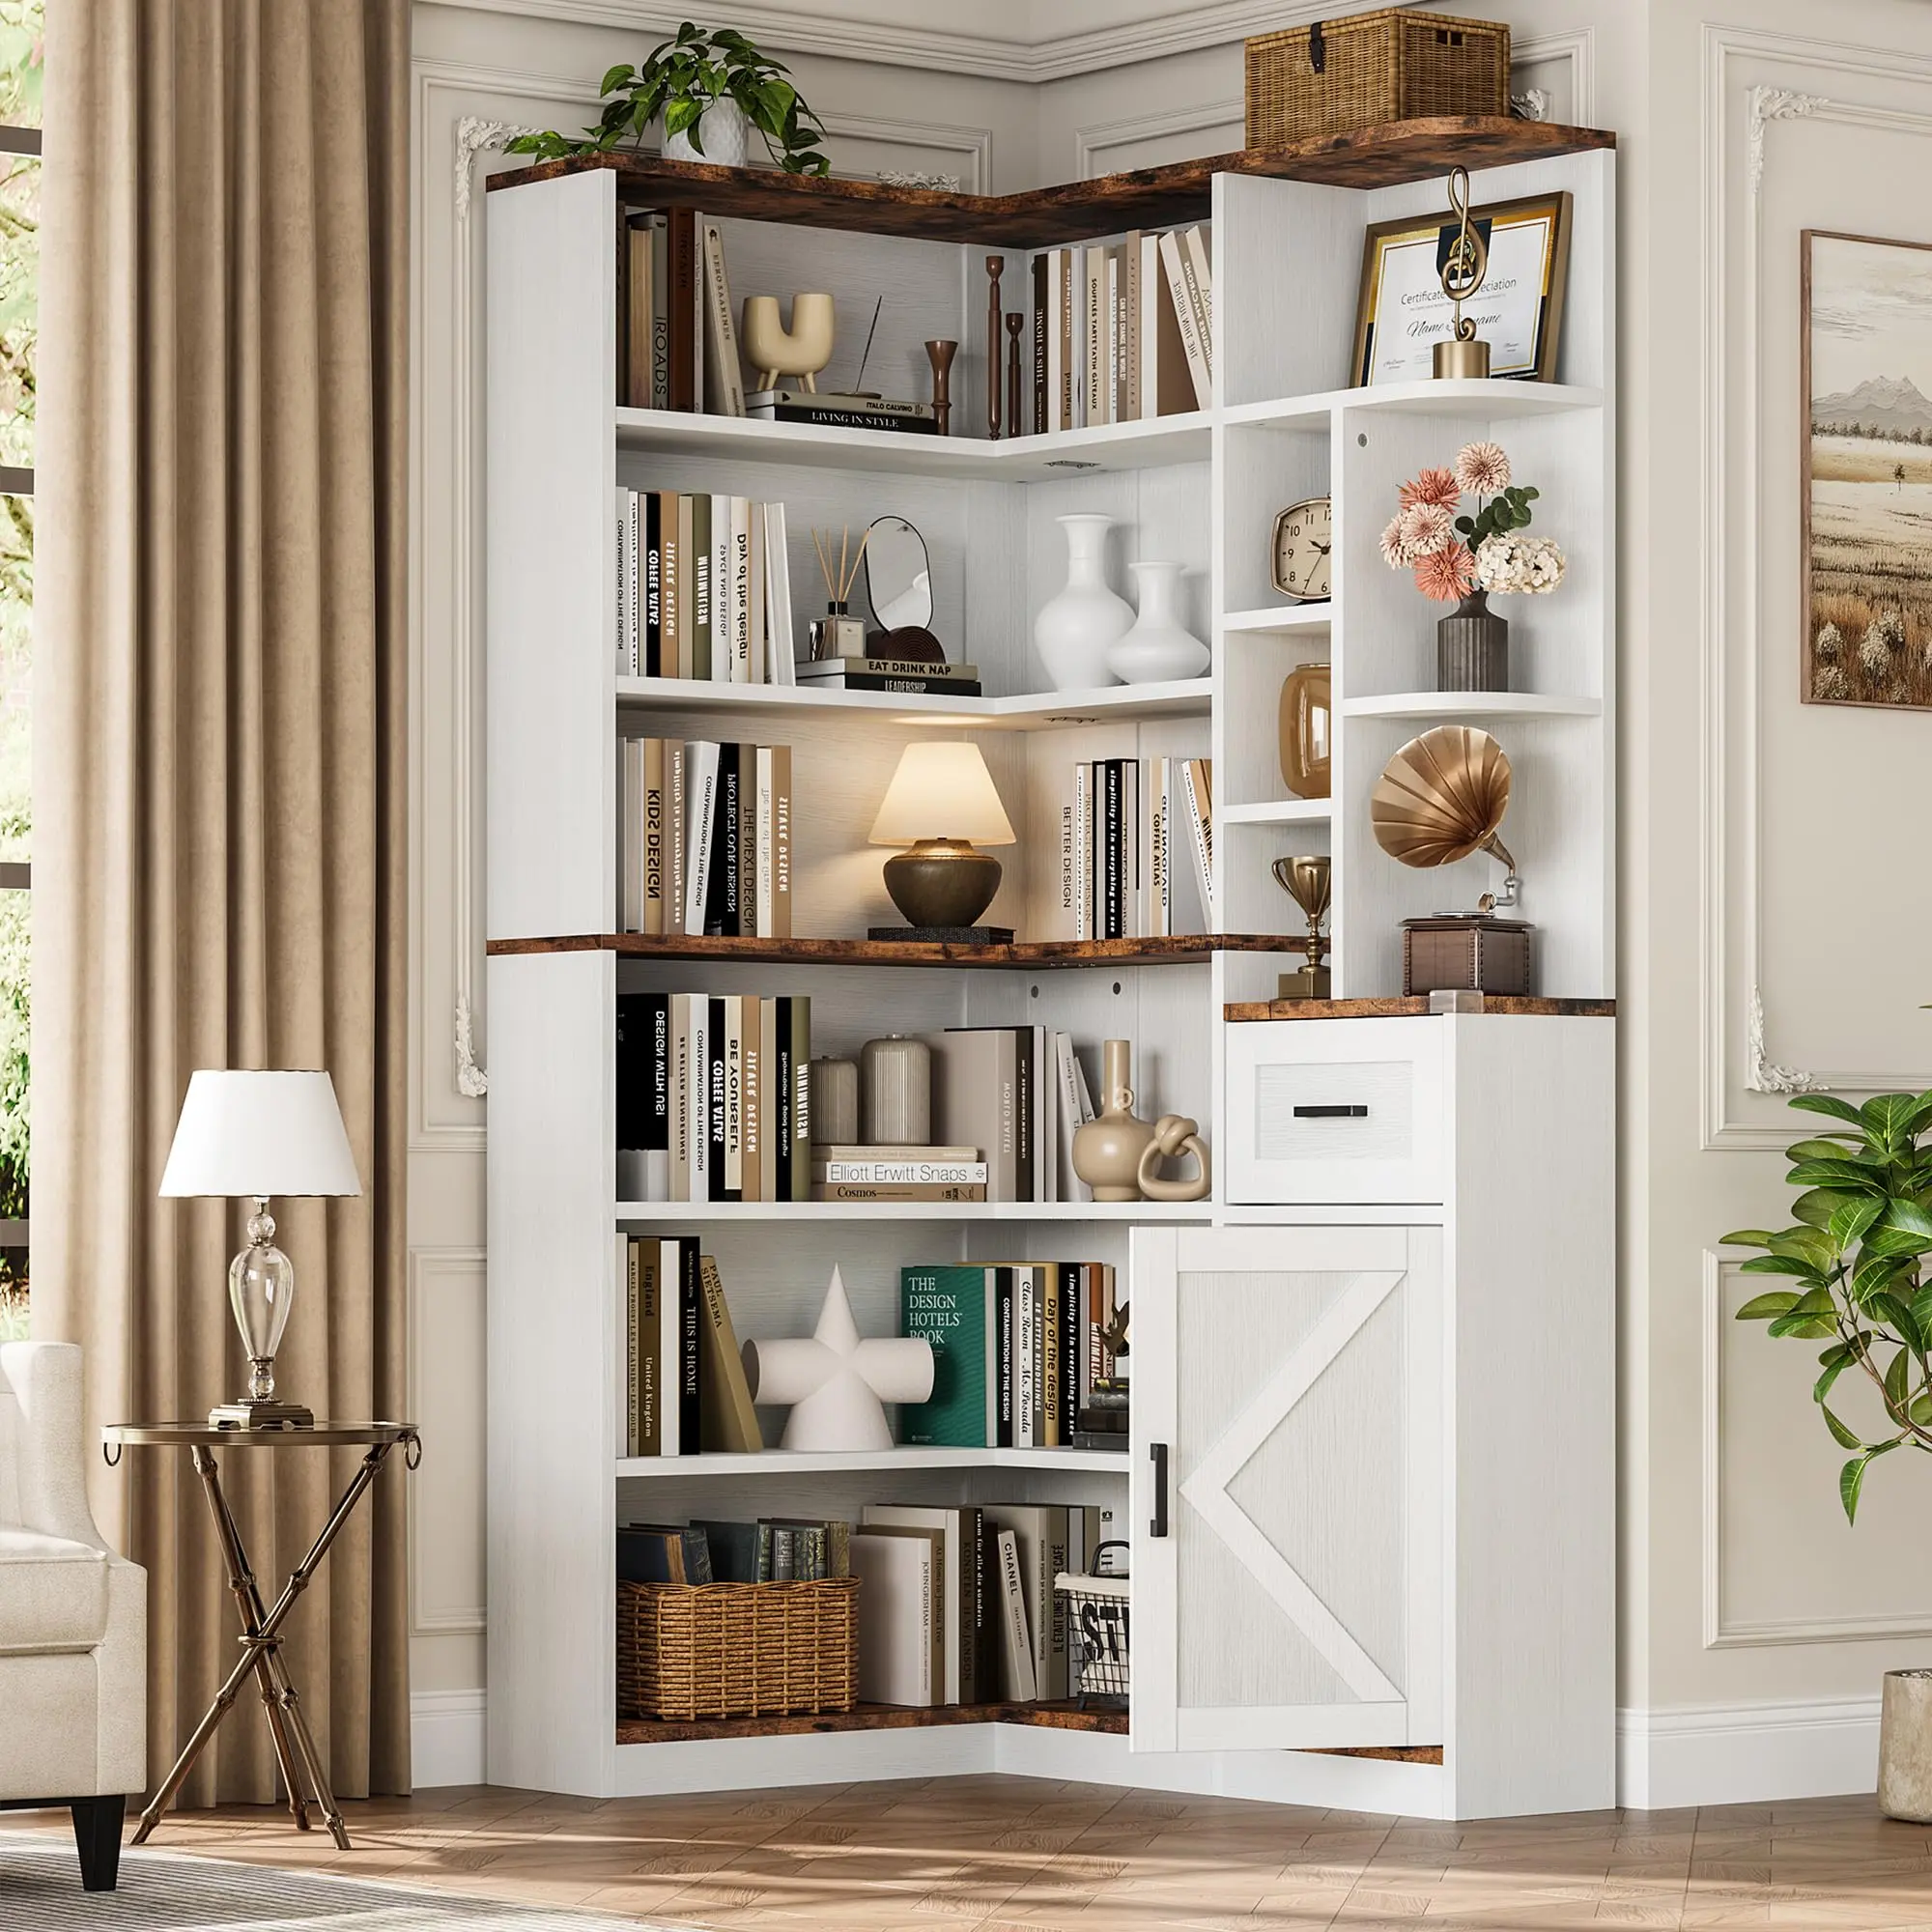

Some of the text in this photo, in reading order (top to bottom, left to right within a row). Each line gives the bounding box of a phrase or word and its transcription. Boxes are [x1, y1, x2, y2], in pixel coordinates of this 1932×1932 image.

[1401, 291, 1445, 305] Certificate
[1406, 321, 1444, 338] Name
[1036, 346, 1043, 355] IS
[812, 412, 848, 422] LIVING
[867, 417, 897, 427] STYLE
[1306, 514, 1314, 525] 11
[1291, 526, 1300, 537] 10
[1288, 549, 1294, 558] 9
[1289, 572, 1296, 582] 8
[1321, 582, 1327, 592] 6
[869, 661, 951, 675] EAT DRINK NAP
[885, 680, 927, 694] LEADERSHIP
[1110, 833, 1117, 841] in
[1110, 900, 1116, 913] we
[831, 1165, 967, 1183] Elliott Erwitt Snaps
[837, 1186, 877, 1198] Cosmos
[710, 1264, 723, 1297] PAUL
[908, 1277, 935, 1291] THE
[644, 1265, 655, 1318] England
[701, 1267, 723, 1328] SIETSEMA
[909, 1294, 956, 1309] DESIGN
[1035, 1303, 1041, 1313] BE
[1068, 1337, 1076, 1346] in
[687, 1307, 696, 1394] THIS IS HOME
[1022, 1282, 1031, 1433] Class Room Ms. Posada
[1045, 1298, 1057, 1422] Day of the design
[1003, 1364, 1010, 1374] OF
[1068, 1405, 1075, 1416] we
[1004, 1544, 1020, 1596] CHANEL
[1052, 1545, 1064, 1653] IL ÉTAIT UNE CAFÉ
